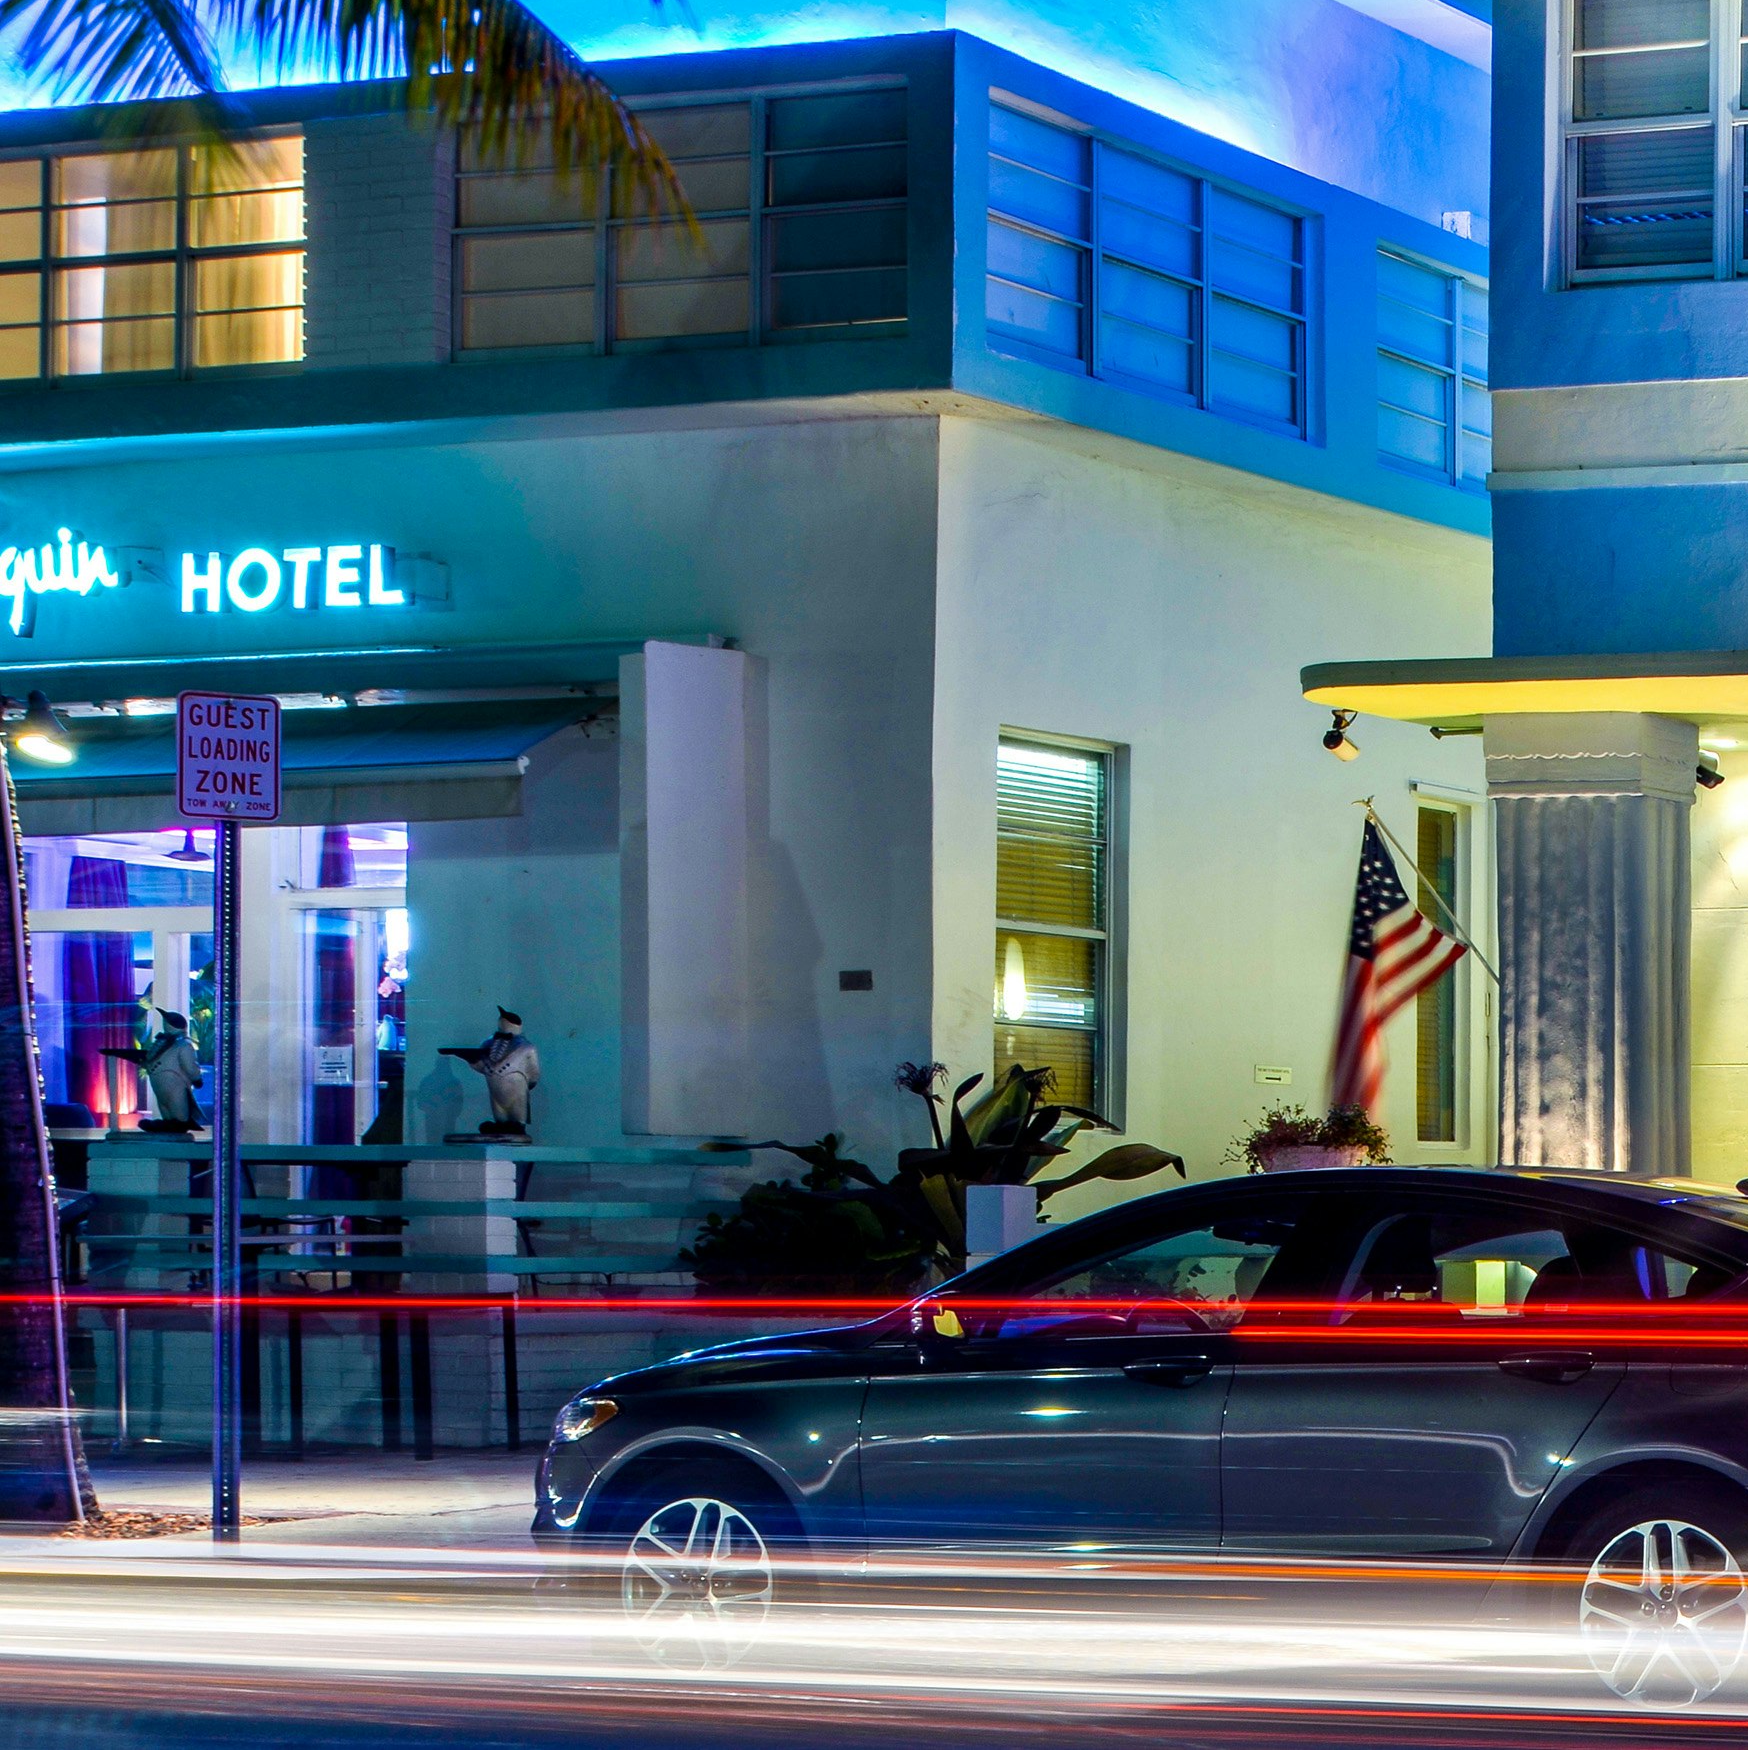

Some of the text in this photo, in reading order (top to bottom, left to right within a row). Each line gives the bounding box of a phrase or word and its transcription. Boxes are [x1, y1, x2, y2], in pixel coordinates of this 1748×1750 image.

[181, 544, 405, 612] HOTEL
[188, 703, 270, 730] GUEST
[188, 736, 270, 763] LOADING
[195, 770, 262, 796] ZONE
[186, 798, 206, 807] TOW
[245, 801, 271, 811] ZONE
